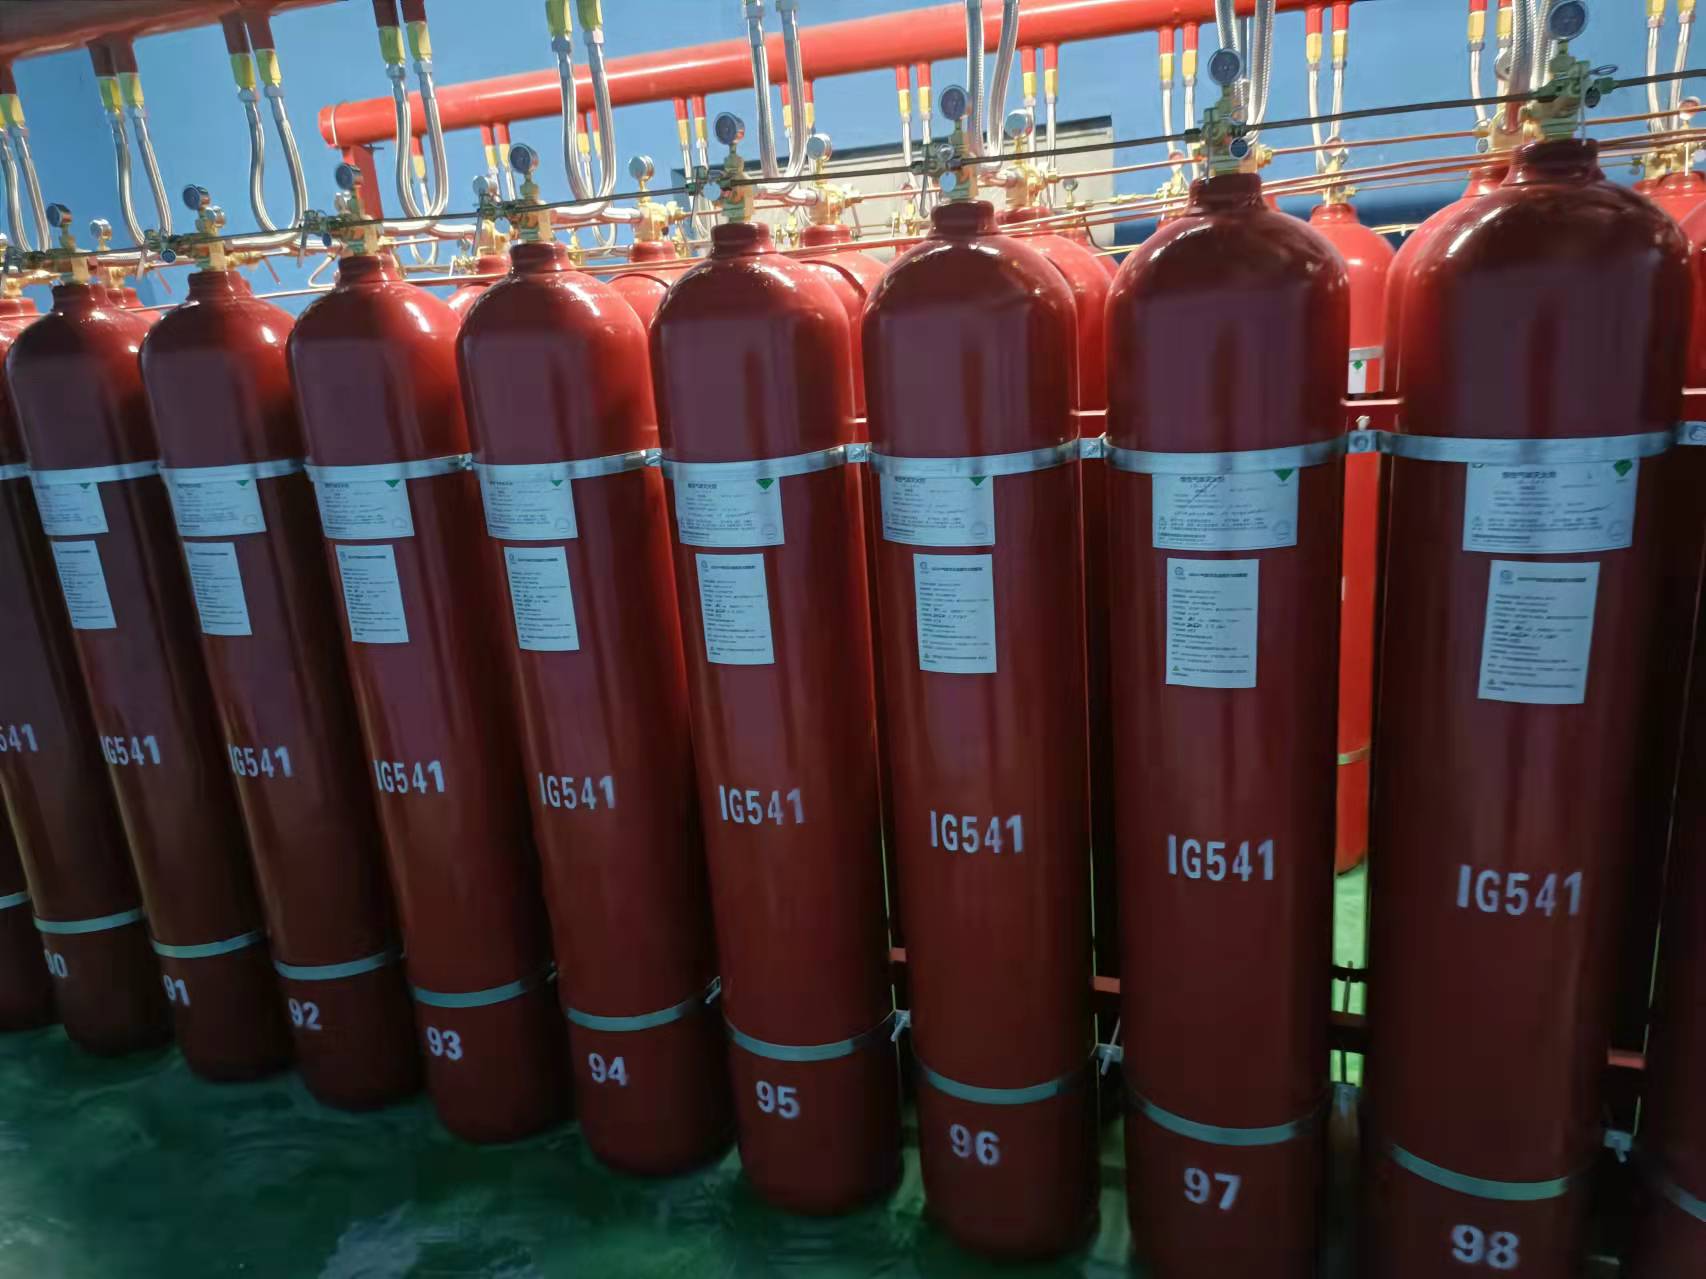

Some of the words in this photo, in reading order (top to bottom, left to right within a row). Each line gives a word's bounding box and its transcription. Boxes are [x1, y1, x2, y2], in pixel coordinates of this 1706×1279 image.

[100, 735, 160, 766] IG541
[228, 744, 292, 778] IG541
[374, 759, 445, 794] IG541
[539, 773, 615, 810] IG541
[719, 785, 804, 825] IG541
[931, 811, 1023, 853] IG541
[1168, 835, 1274, 881] IG541
[1457, 865, 1583, 917] IG541
[163, 975, 190, 1005] 91
[289, 999, 322, 1030] 92
[427, 1027, 463, 1060] 93
[589, 1053, 628, 1085] 94
[756, 1081, 801, 1118] 95
[950, 1124, 1000, 1165] 96
[1184, 1168, 1241, 1210] 97
[1452, 1225, 1519, 1269] 98
